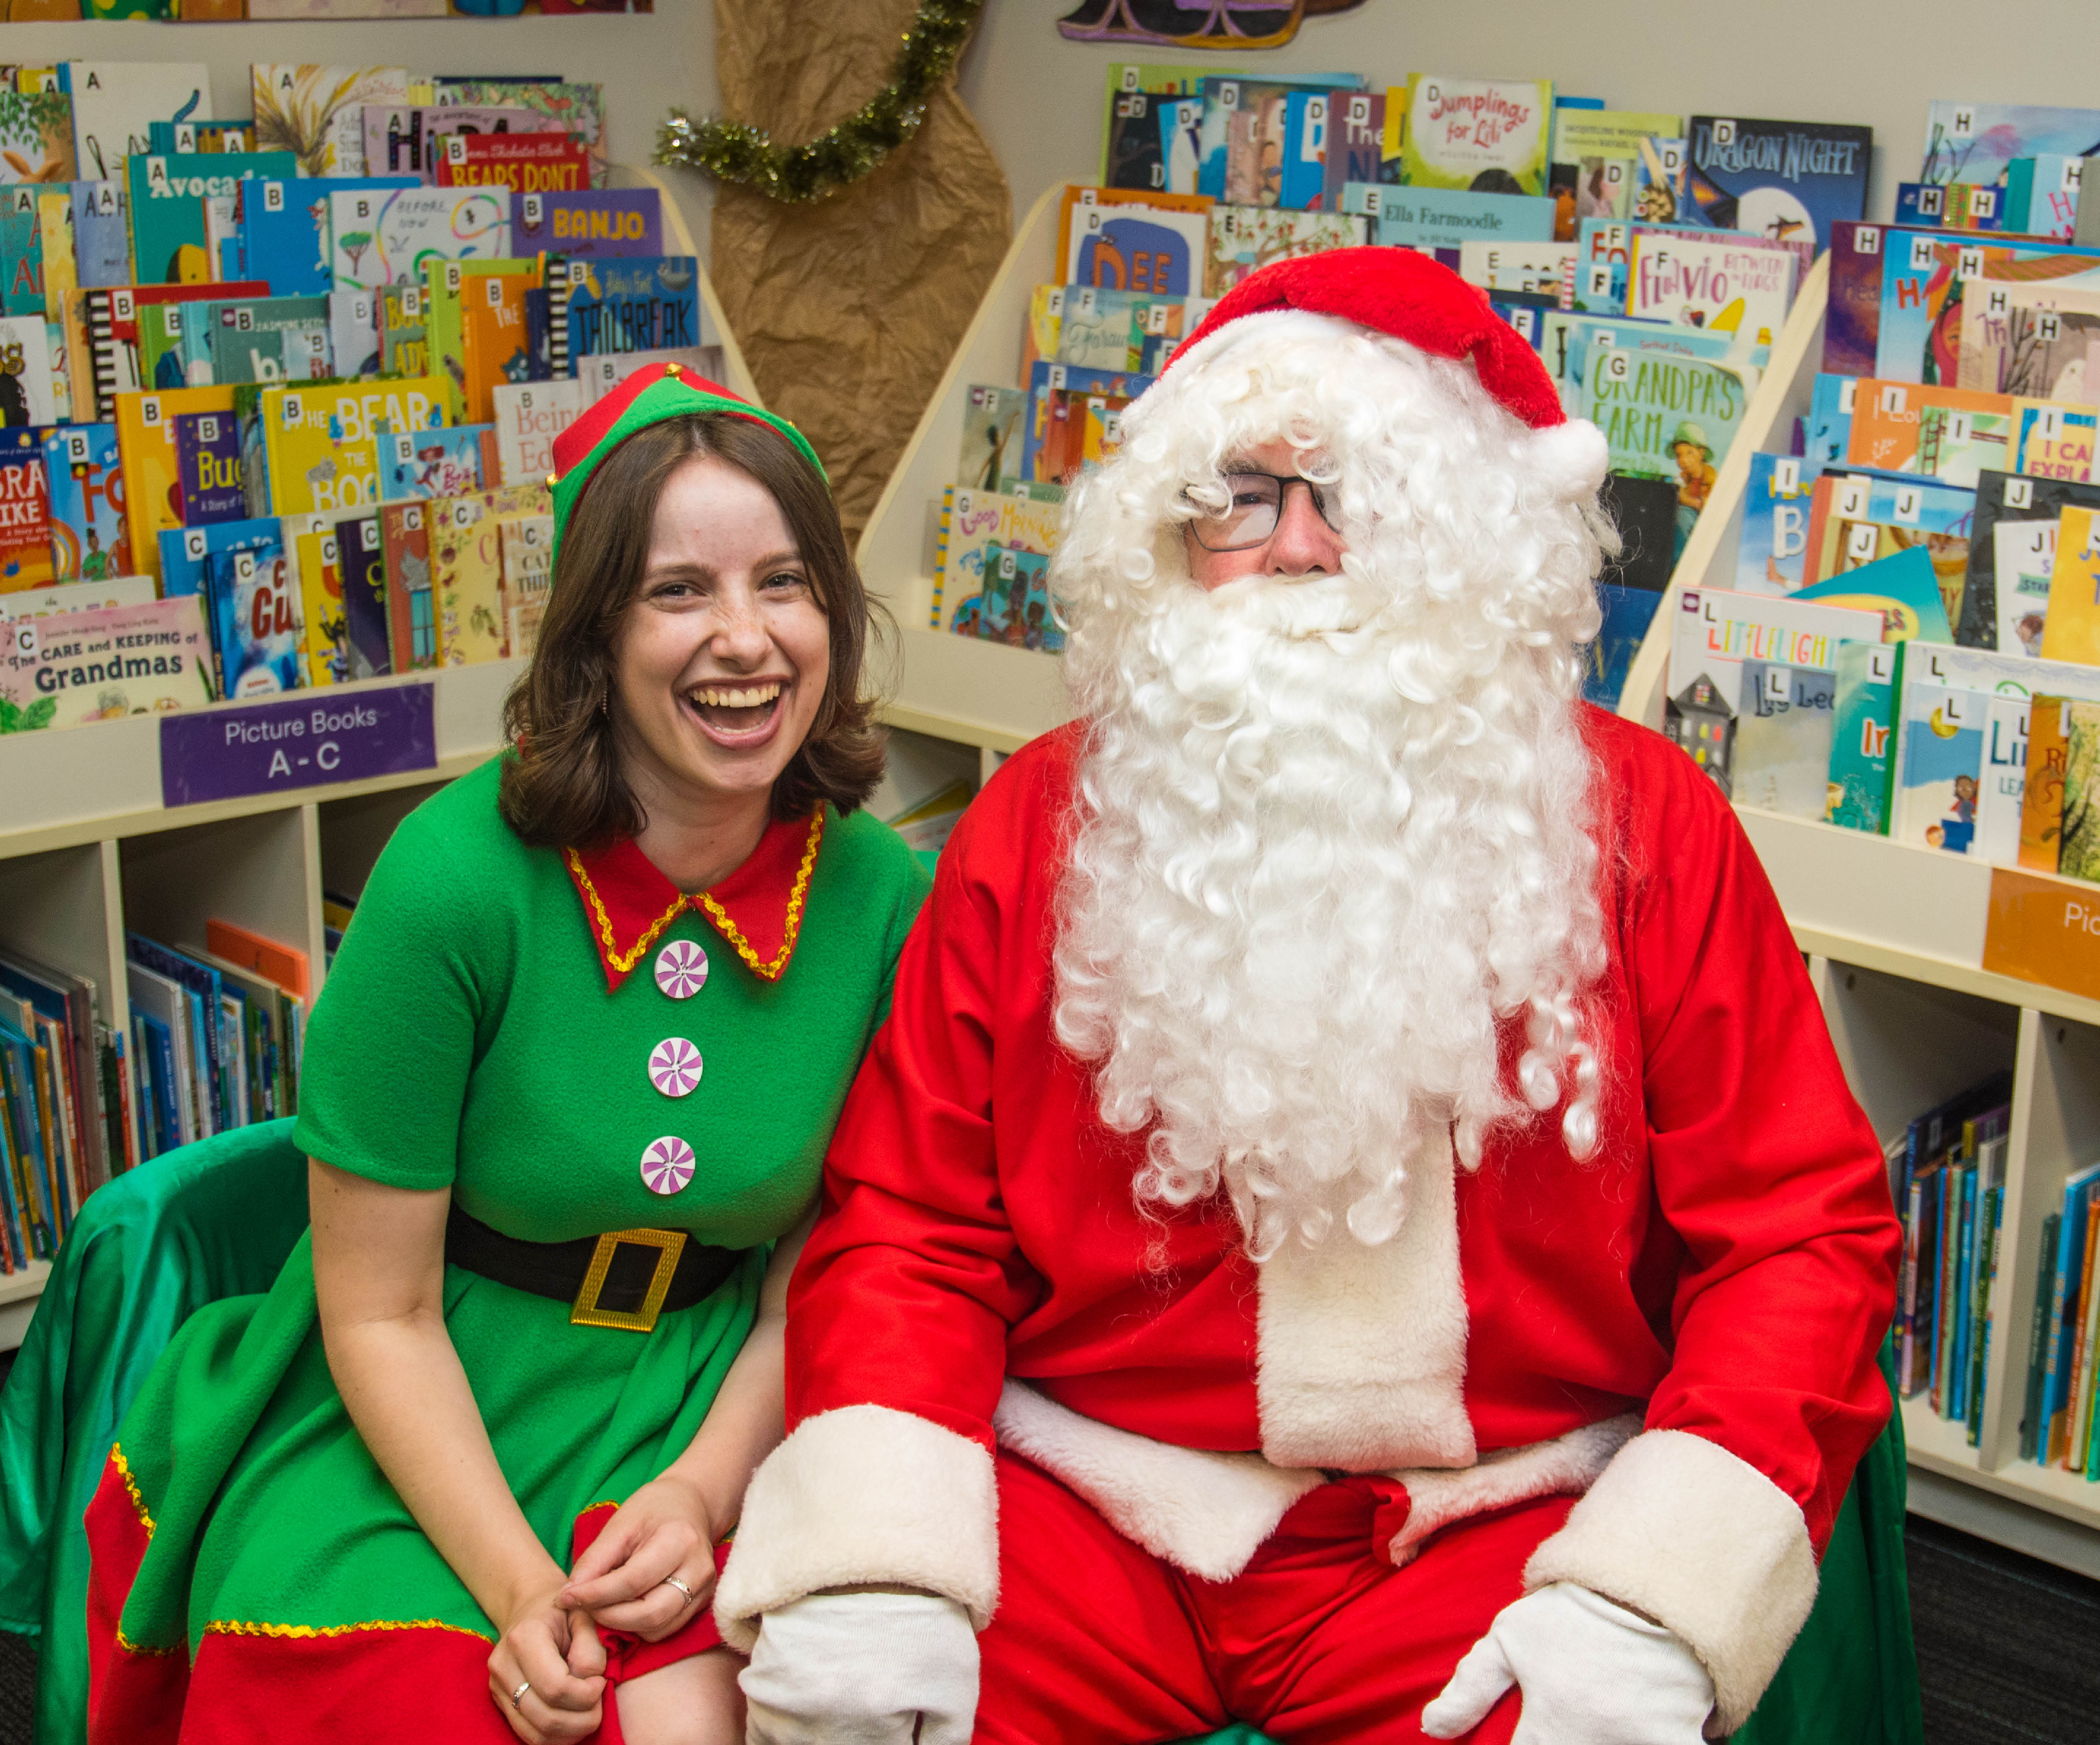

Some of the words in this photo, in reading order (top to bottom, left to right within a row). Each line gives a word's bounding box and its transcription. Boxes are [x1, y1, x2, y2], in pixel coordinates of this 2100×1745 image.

[87, 72, 100, 89] A
[281, 74, 294, 89] A
[1127, 73, 1136, 87] D
[1223, 89, 1234, 104] D
[1428, 86, 1439, 102] D
[1134, 100, 1145, 115] D
[1180, 108, 1190, 123] D
[1311, 103, 1322, 119] D
[1353, 103, 1365, 119] D
[390, 113, 401, 130] A
[1955, 113, 1970, 132] H
[180, 131, 193, 148] A
[1446, 121, 1470, 143] for
[1474, 117, 1502, 148] Lili
[1718, 125, 1731, 142] D
[451, 143, 461, 158] B
[1665, 151, 1678, 168] D
[152, 164, 164, 180] A
[1608, 166, 1621, 183] D
[2067, 167, 2083, 186] H
[19, 193, 32, 210] A
[101, 189, 113, 206] A
[269, 189, 280, 205] B
[1366, 193, 1377, 210] E
[1922, 192, 1937, 211] H
[1975, 195, 1990, 213] H
[358, 201, 368, 217] B
[526, 201, 538, 216] B
[1089, 213, 1100, 229] D
[1226, 215, 1234, 234] E
[1385, 204, 1414, 223] Ella
[1420, 206, 1503, 231] Farmoodle
[1611, 227, 1621, 243] F
[1861, 231, 1875, 250] H
[1489, 252, 1499, 269] E
[1658, 252, 1668, 269] F
[1916, 244, 1931, 262] H
[1962, 255, 1977, 274] H
[449, 269, 458, 284] B
[574, 267, 583, 281] B
[1594, 274, 1605, 292] F
[491, 286, 500, 301] B
[1082, 294, 1092, 310] F
[1991, 292, 2006, 311] H
[118, 298, 130, 315] B
[356, 302, 366, 318] B
[407, 294, 417, 311] B
[1052, 296, 1060, 311] F
[169, 313, 180, 329] B
[239, 313, 251, 330] B
[1154, 311, 1164, 326] F
[2041, 318, 2057, 338] H
[313, 335, 323, 352] B
[603, 364, 614, 379] B
[1612, 358, 1626, 375] G
[522, 393, 532, 408] B
[1891, 393, 1896, 411] I
[145, 404, 157, 421] B
[287, 401, 300, 418] B
[336, 393, 430, 443] BEAR
[203, 422, 215, 438] B
[1957, 420, 1962, 438] I
[2046, 414, 2052, 432] I
[72, 438, 84, 455] B
[400, 441, 411, 458] B
[1785, 467, 1791, 486] I
[2011, 484, 2026, 504] J
[960, 497, 970, 512] G
[1845, 494, 1858, 513] J
[1900, 495, 1913, 514] J
[407, 512, 418, 529] C
[456, 507, 467, 523] C
[366, 527, 377, 543] C
[525, 528, 536, 545] C
[1857, 533, 1870, 552] J
[2031, 532, 2043, 552] J
[189, 537, 202, 554] C
[324, 542, 335, 559] C
[240, 560, 252, 577] C
[1003, 557, 1014, 574] G
[1705, 603, 1717, 622] L
[19, 631, 33, 650] C
[41, 642, 82, 661] CARE
[87, 638, 110, 653] and
[115, 632, 180, 649] KEEPING
[185, 632, 198, 644] of
[35, 654, 183, 693] Grandmas
[1873, 656, 1885, 677] L
[1932, 656, 1945, 677] L
[1771, 674, 1783, 694] L
[1948, 698, 1961, 719] L
[226, 717, 305, 745] Picture
[311, 707, 377, 733] Books
[269, 750, 292, 779] A
[317, 742, 340, 770] C
